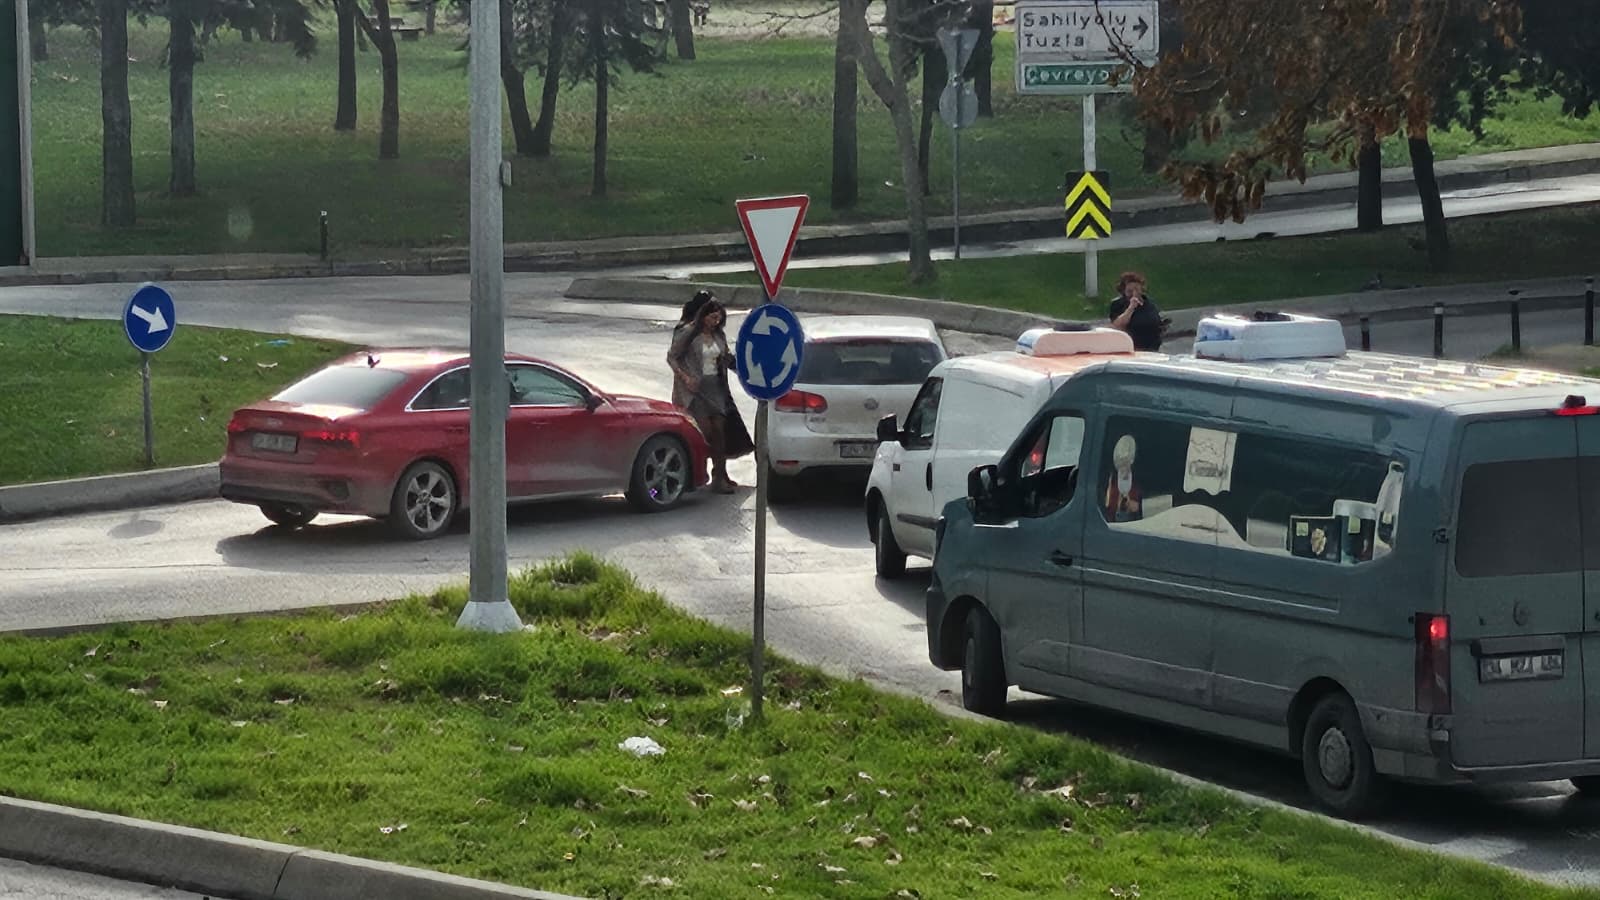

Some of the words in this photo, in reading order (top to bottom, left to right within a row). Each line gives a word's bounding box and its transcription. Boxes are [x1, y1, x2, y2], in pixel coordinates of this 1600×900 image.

[1023, 10, 1126, 30] Sahilyolu
[1024, 33, 1084, 48] Tuzla
[1027, 66, 1131, 85] Çevreyou
